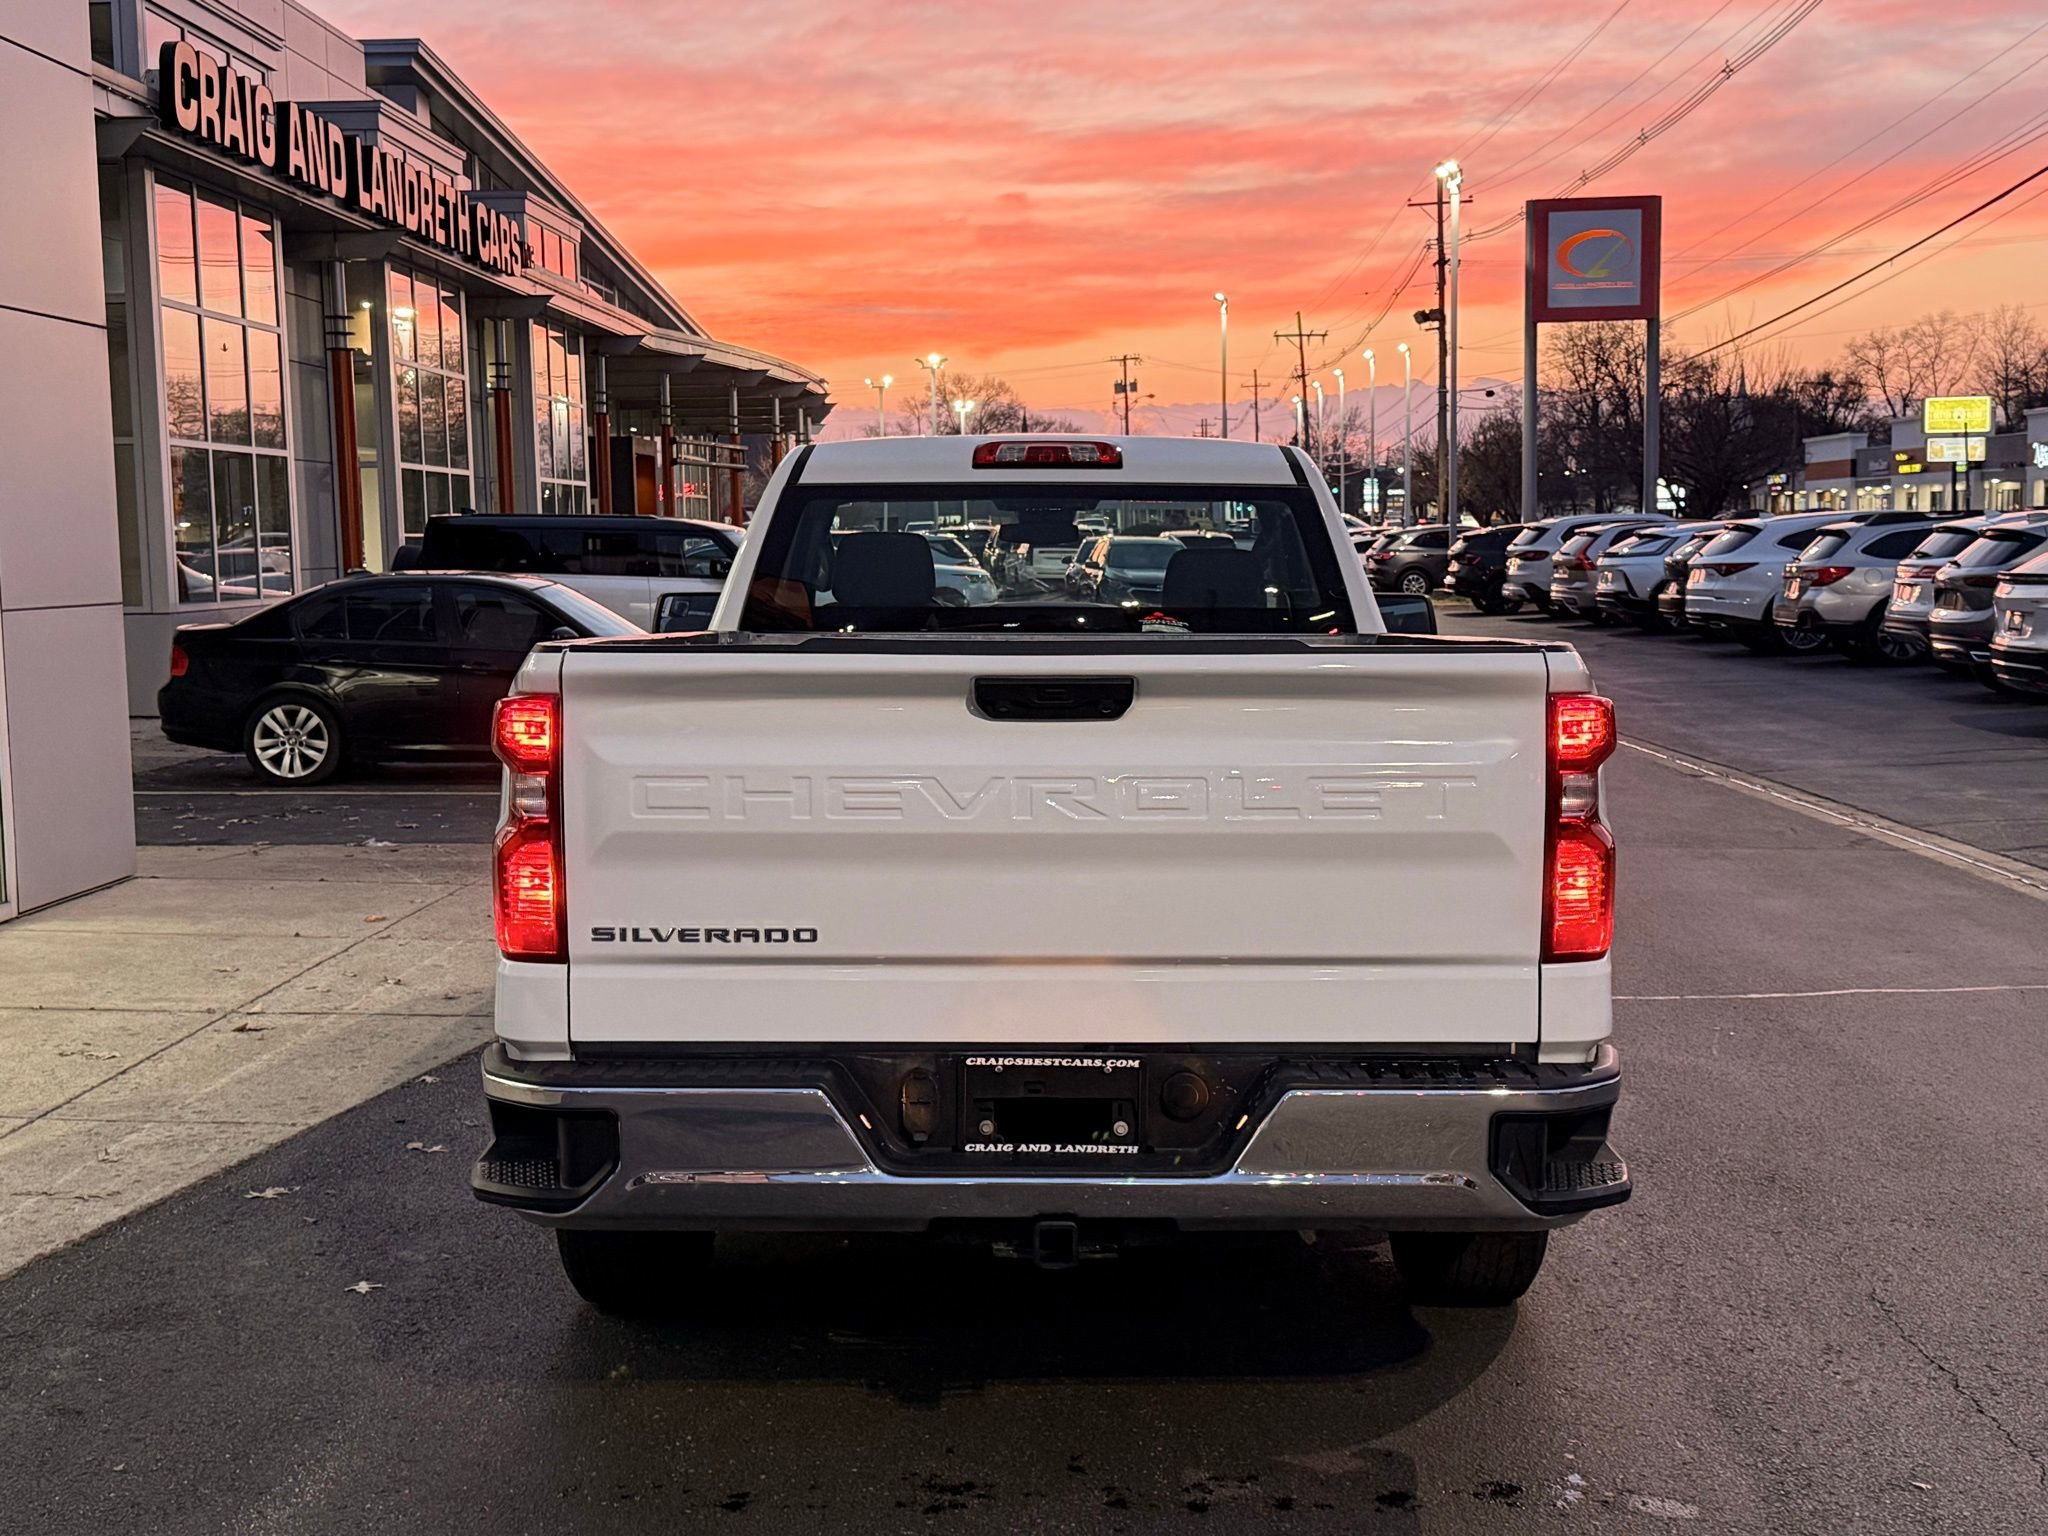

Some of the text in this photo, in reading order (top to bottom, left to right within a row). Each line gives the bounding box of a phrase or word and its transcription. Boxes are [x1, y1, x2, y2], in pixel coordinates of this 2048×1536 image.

[170, 41, 522, 277] CRAIG AND LANDRETH CARS
[628, 774, 1478, 821] CHEVROLET
[590, 927, 819, 943] SILVERADO
[965, 1057, 1140, 1068] CRAIGSBESTCARS.COM
[964, 1143, 1139, 1154] CRAIG AND LANDRETH
